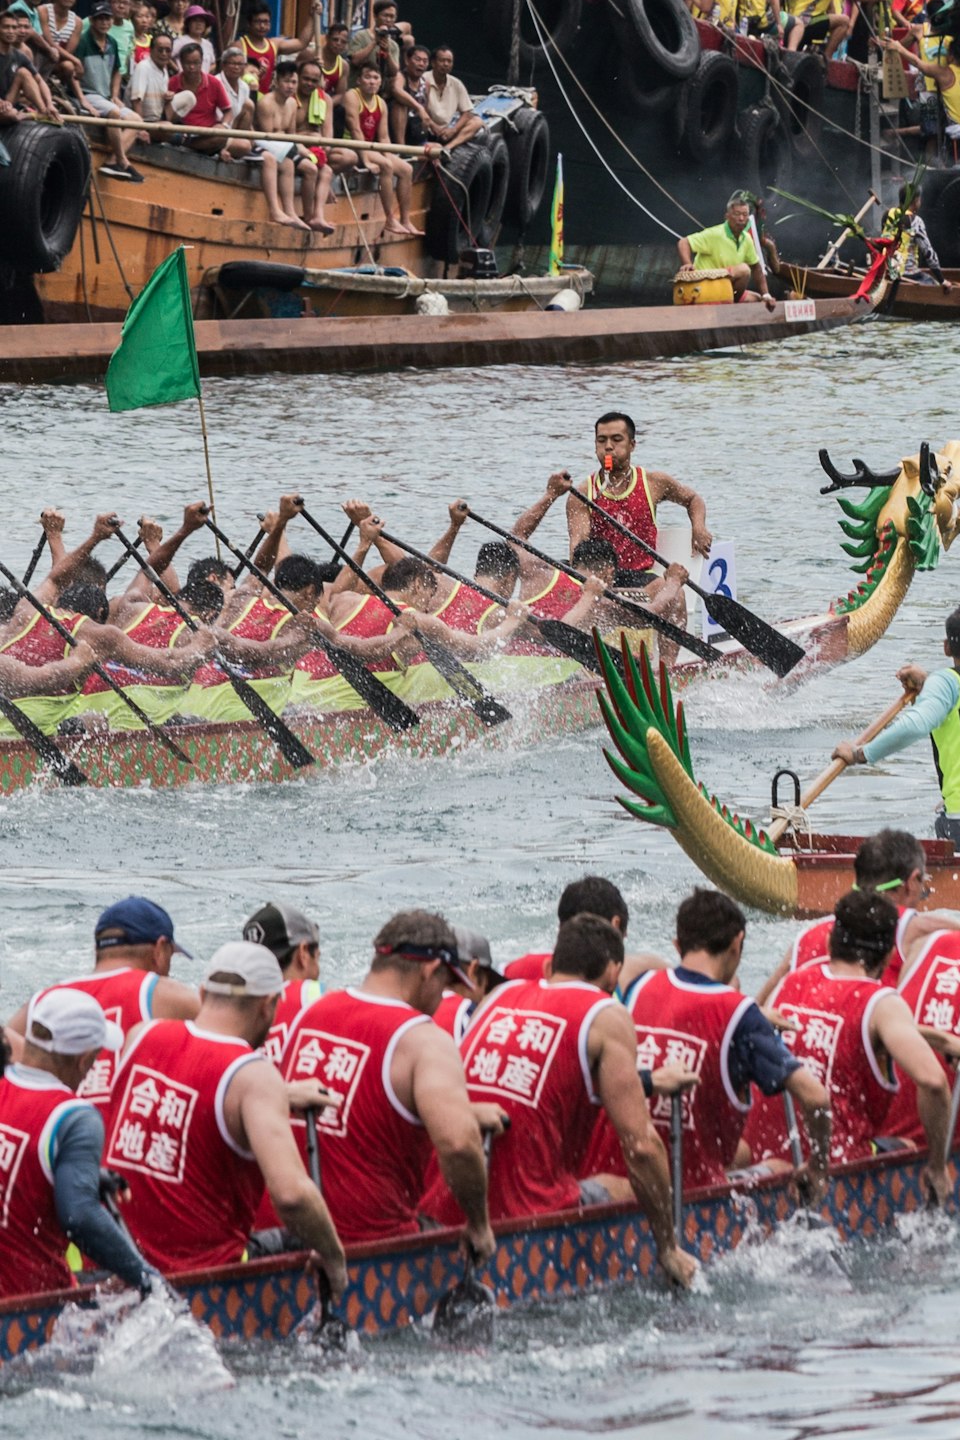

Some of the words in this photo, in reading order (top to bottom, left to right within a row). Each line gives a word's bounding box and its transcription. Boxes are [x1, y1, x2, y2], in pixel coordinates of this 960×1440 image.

[486, 1014, 556, 1053] 合和
[297, 1037, 360, 1082] 合和
[469, 1047, 540, 1093] 地產
[129, 1081, 188, 1129] 合和
[115, 1124, 179, 1171] 地產
